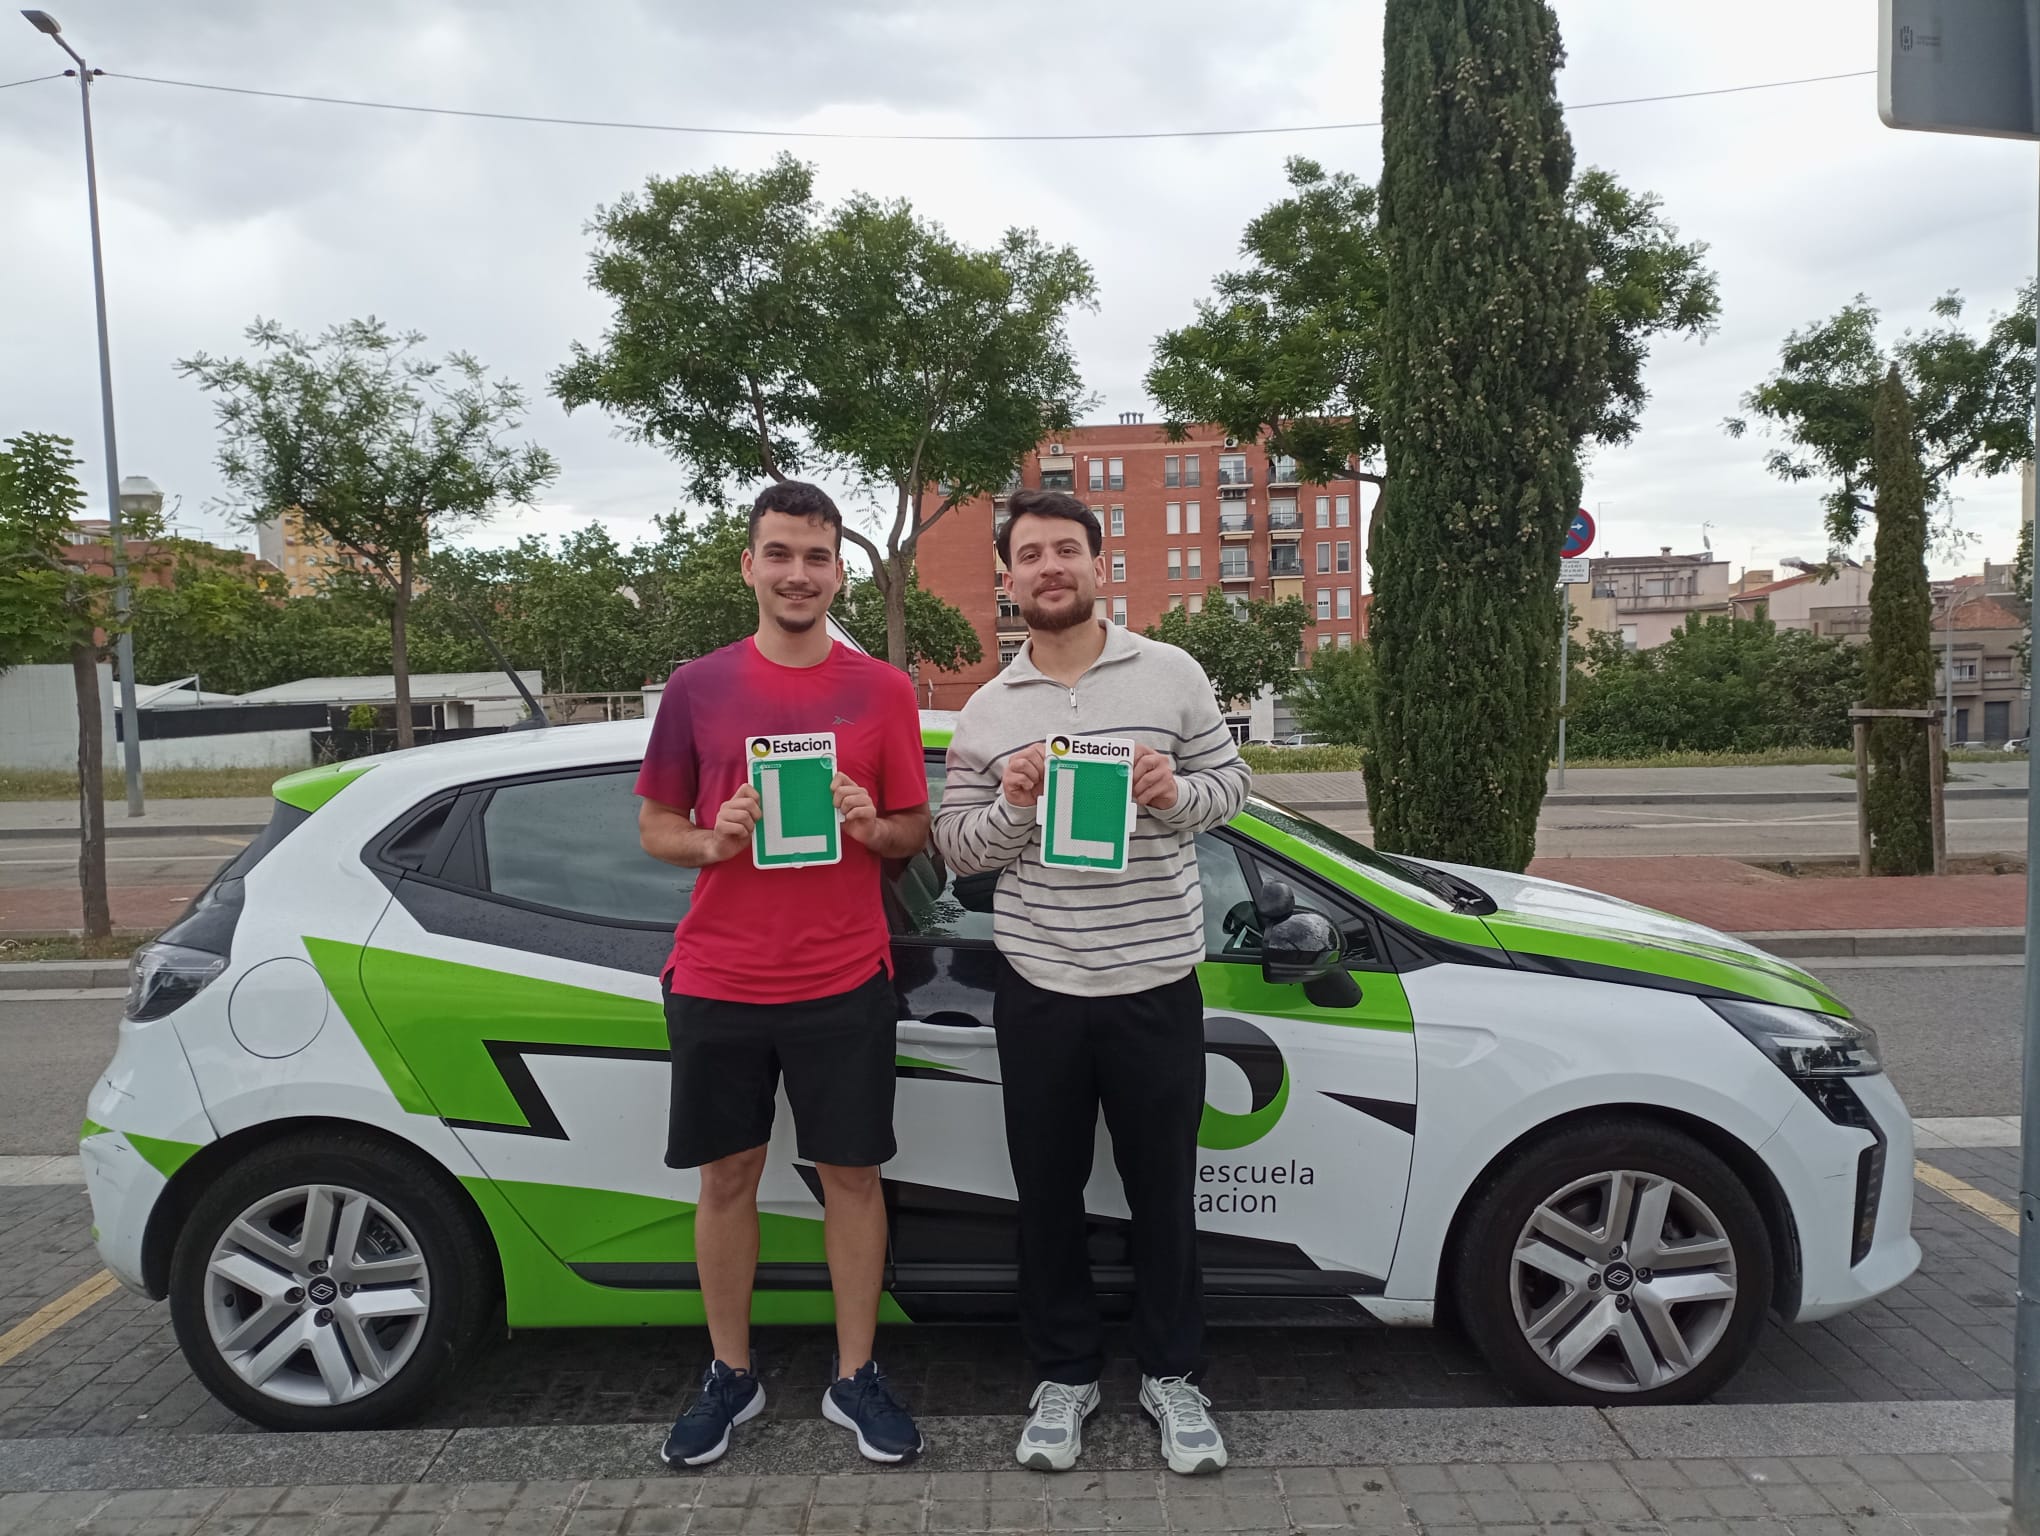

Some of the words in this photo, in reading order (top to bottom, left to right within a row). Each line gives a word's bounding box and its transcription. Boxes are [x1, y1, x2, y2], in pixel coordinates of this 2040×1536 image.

[773, 738, 831, 753] Estacion
[1072, 741, 1130, 757] Estacion
[761, 769, 828, 856] L
[1052, 768, 1115, 860] L
[1194, 1187, 1276, 1213] acion
